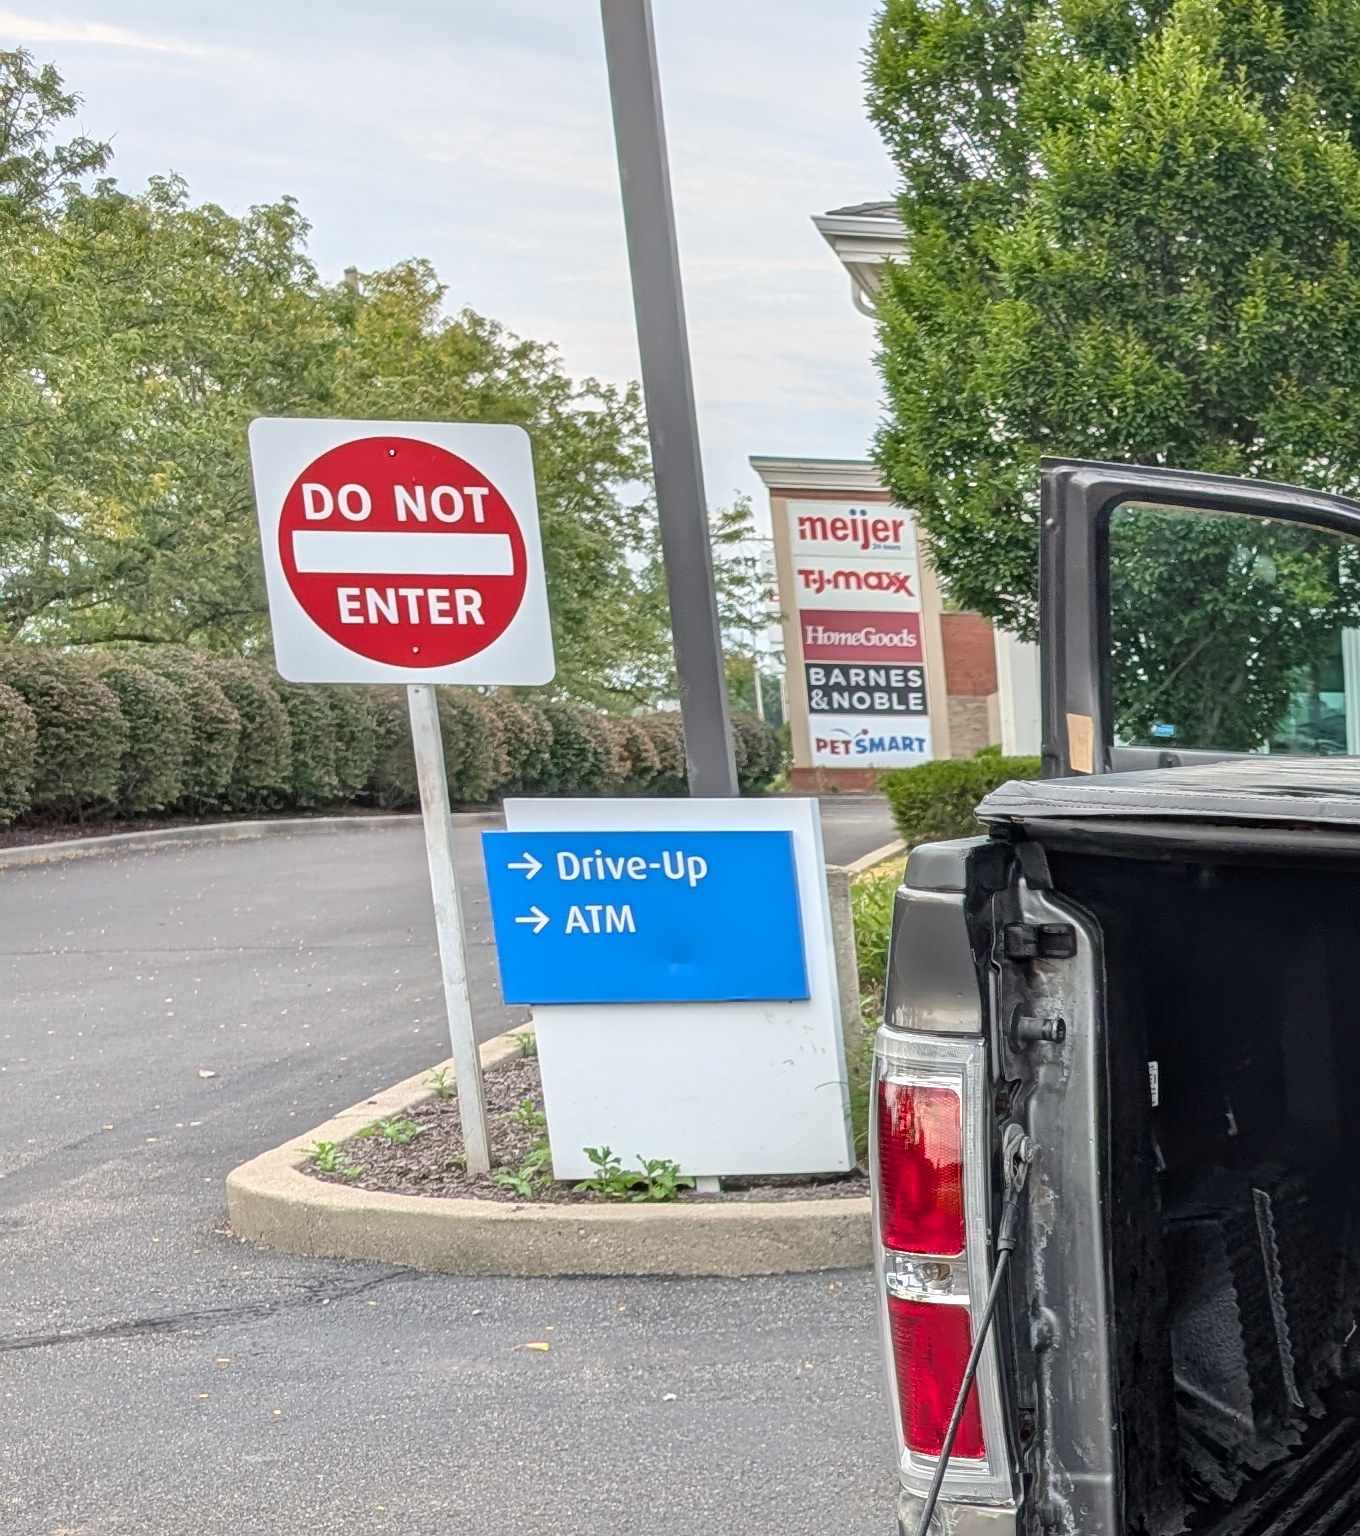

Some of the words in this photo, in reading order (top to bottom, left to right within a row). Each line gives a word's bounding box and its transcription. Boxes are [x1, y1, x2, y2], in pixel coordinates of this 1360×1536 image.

[301, 482, 373, 522] DO
[394, 484, 490, 524] NOT
[797, 508, 904, 550] meijer
[336, 586, 486, 626] ENTER
[805, 625, 918, 648] HomeGoods
[808, 667, 923, 688] BARNES
[556, 848, 709, 888] Drive-Up
[563, 904, 638, 935] ATM
